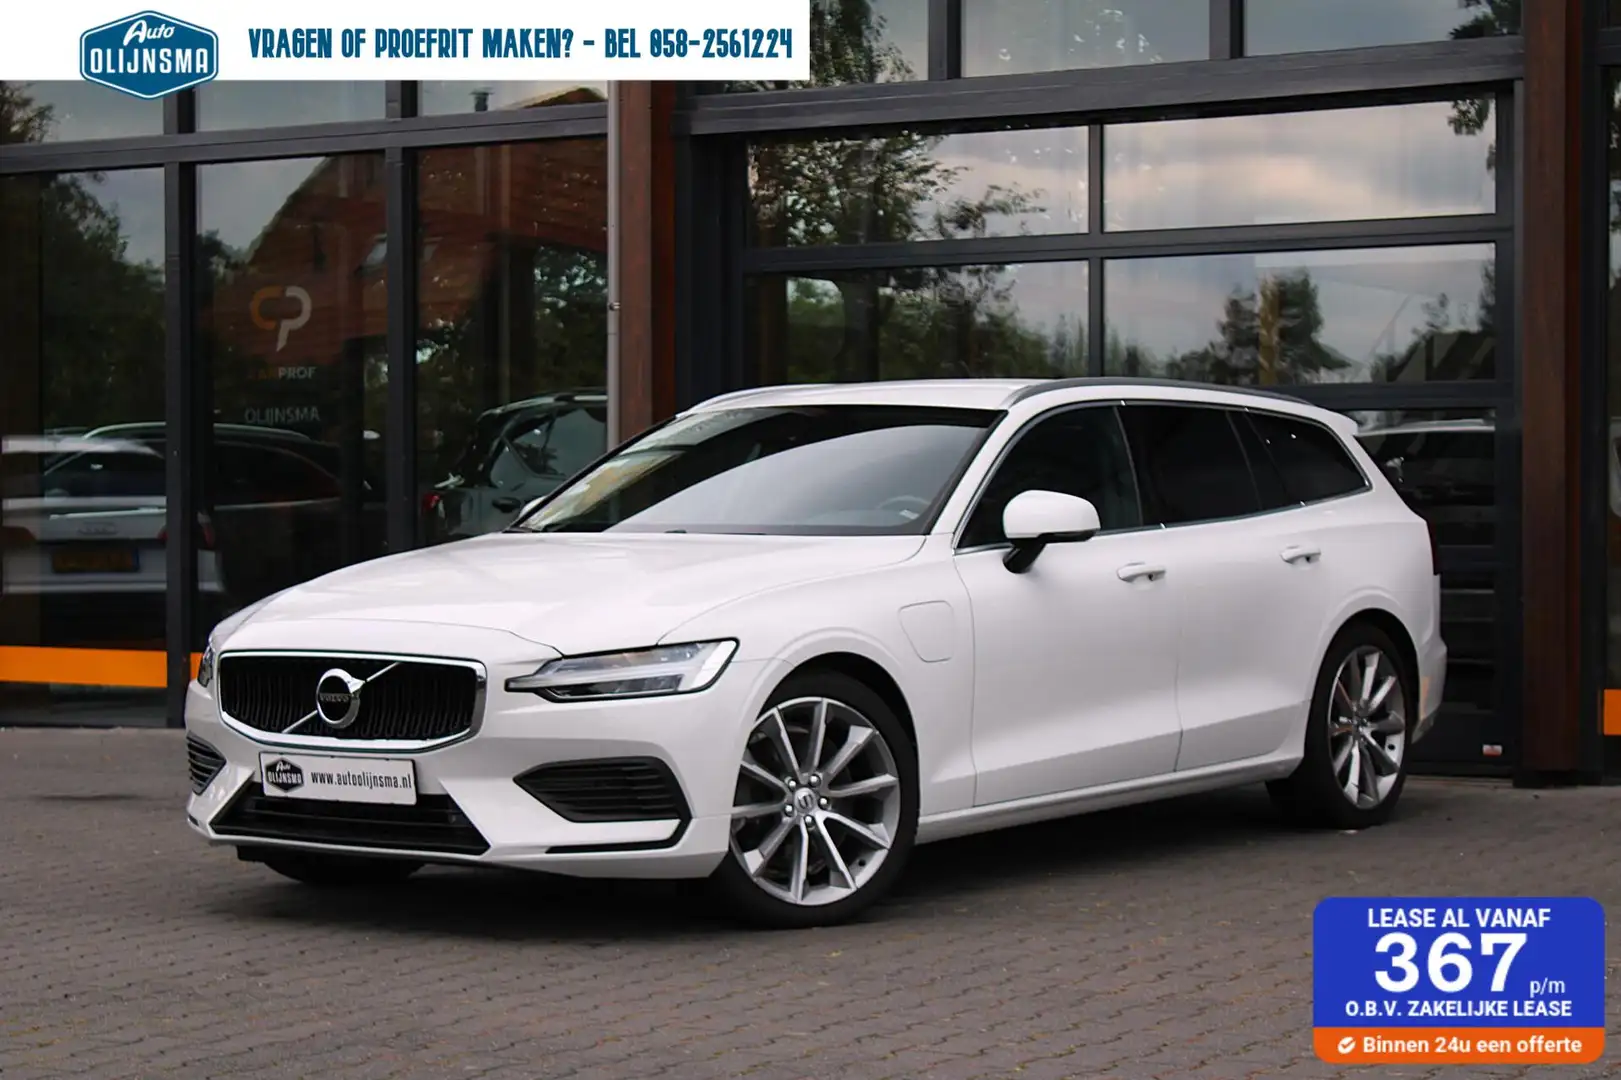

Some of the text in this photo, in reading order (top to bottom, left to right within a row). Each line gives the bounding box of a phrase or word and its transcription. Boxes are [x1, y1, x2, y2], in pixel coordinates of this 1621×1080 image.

[244, 406, 321, 425] OLIJNSMA
[319, 692, 350, 703] VOLVO
[311, 770, 412, 790] www.autoolijnsma.nl
